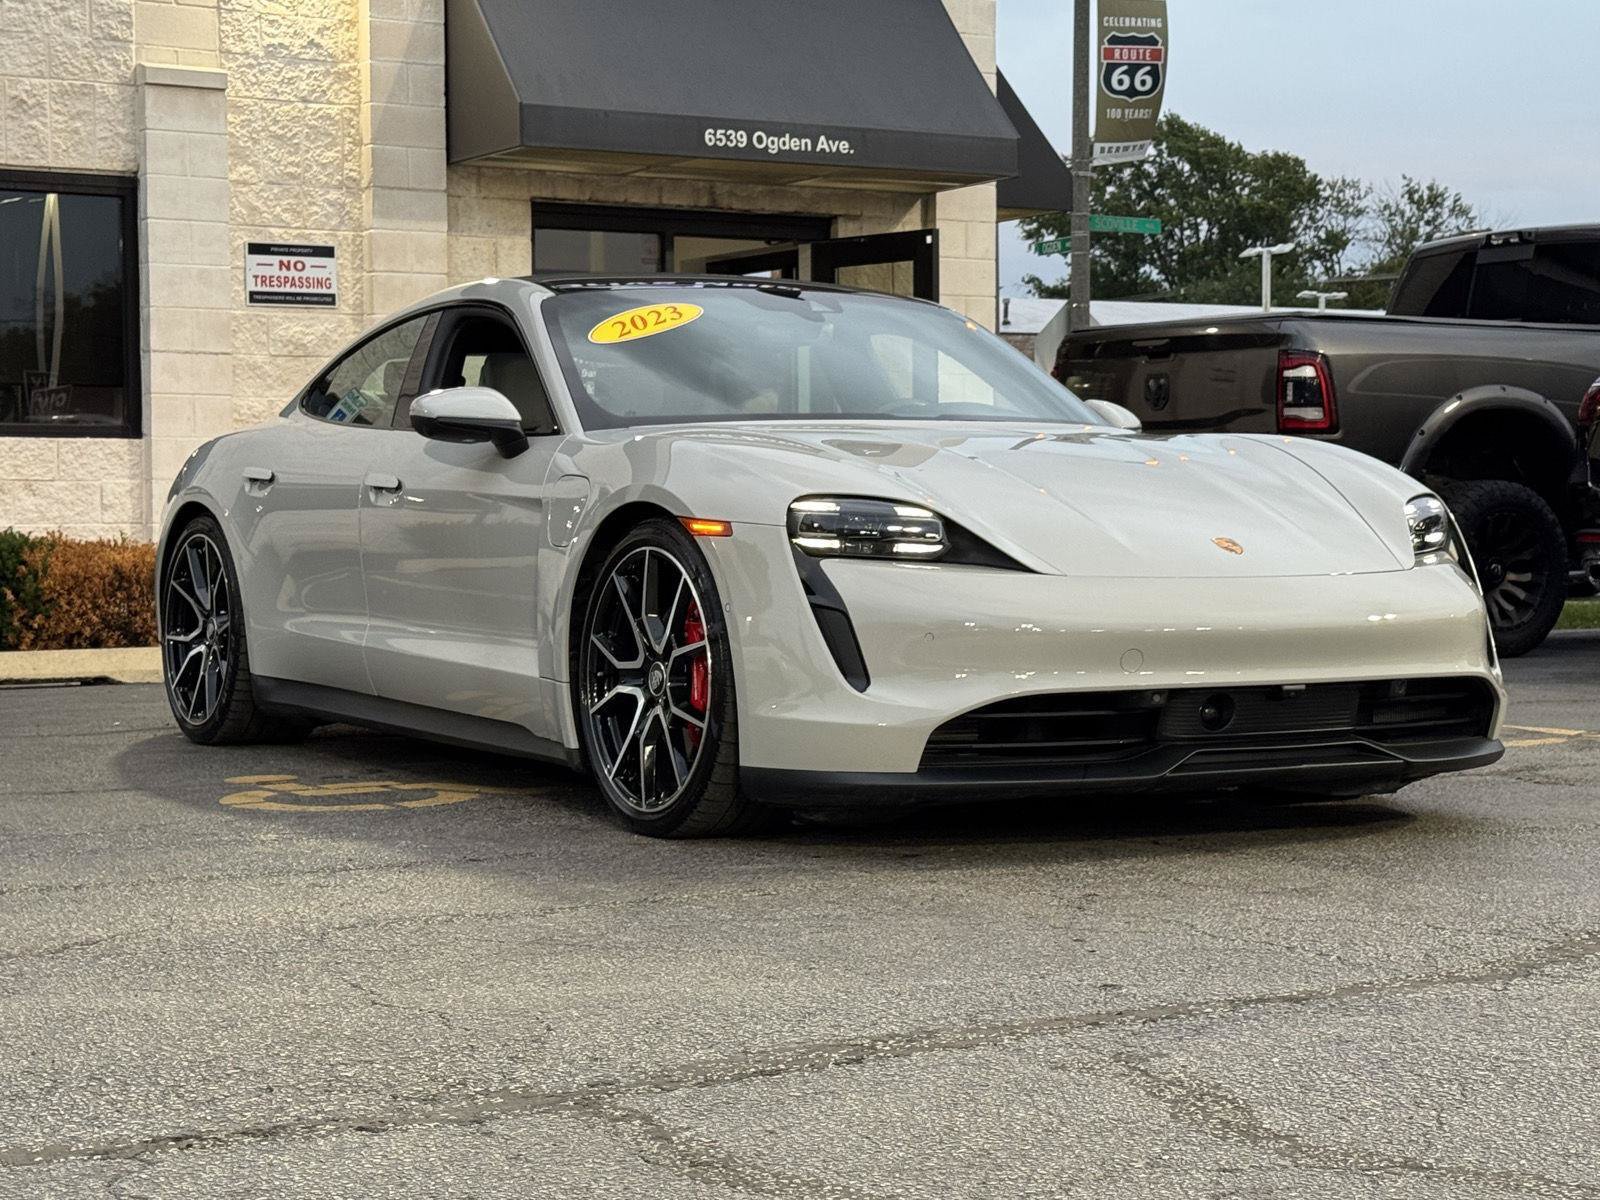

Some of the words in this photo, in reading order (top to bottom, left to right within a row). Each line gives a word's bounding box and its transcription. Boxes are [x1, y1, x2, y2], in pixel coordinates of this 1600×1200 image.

[1103, 16, 1162, 28] CELEBRATING
[1114, 48, 1152, 60] ROUTE
[1111, 65, 1153, 91] 66
[1106, 108, 1122, 119] 100
[704, 128, 748, 148] 6539
[752, 131, 812, 154] Ogden
[815, 135, 855, 154] Ave.
[1100, 143, 1146, 154] BERWYN
[1042, 240, 1062, 254] OGDEN
[278, 260, 306, 272] NO
[253, 275, 332, 290] TRESPASSING
[611, 305, 684, 338] 2023
